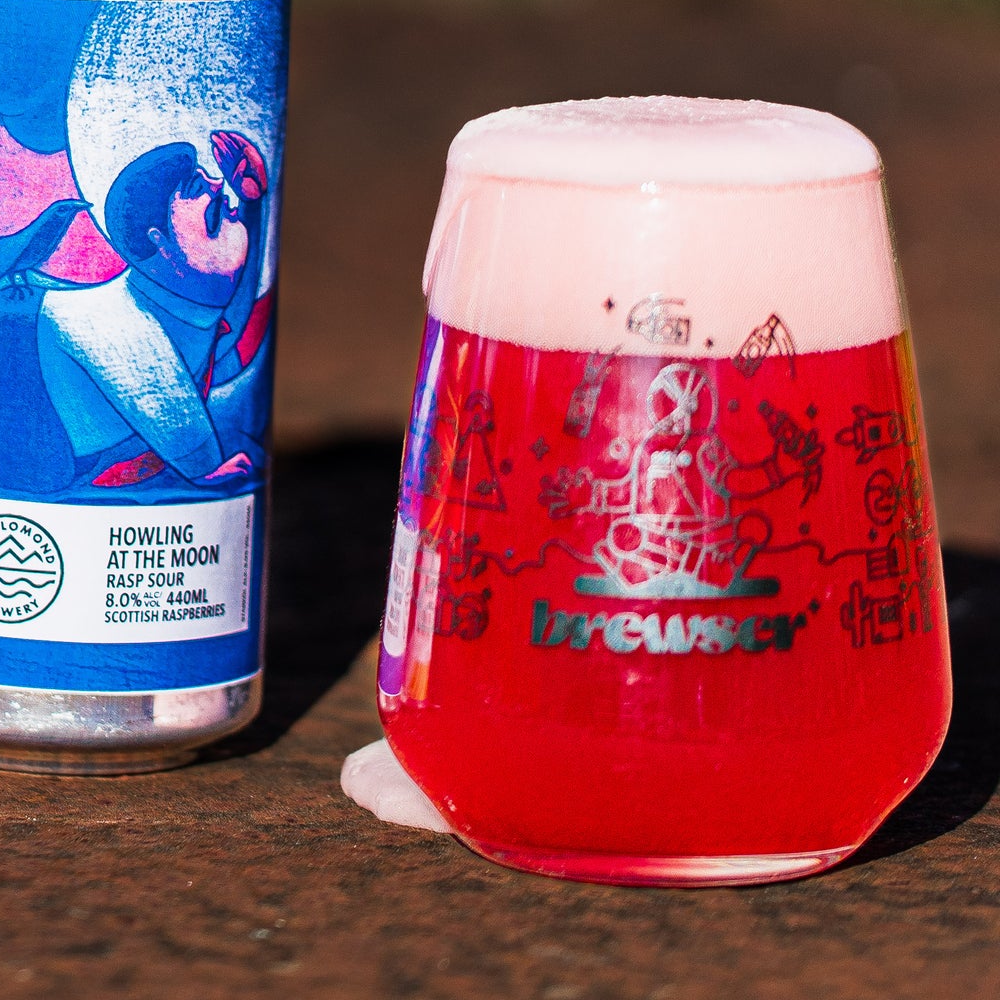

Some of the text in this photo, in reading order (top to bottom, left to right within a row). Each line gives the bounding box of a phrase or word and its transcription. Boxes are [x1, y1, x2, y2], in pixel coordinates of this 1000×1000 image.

[0, 520, 55, 565] LOMOND
[109, 524, 194, 546] HOWLING
[106, 544, 220, 569] AT THE MOON
[106, 571, 185, 588] RASP SOUR
[105, 592, 142, 608] 8.0%
[166, 588, 208, 605] 440ML
[104, 603, 226, 623] SCOTTISH RASPBERRIES
[531, 600, 806, 654] brewser
